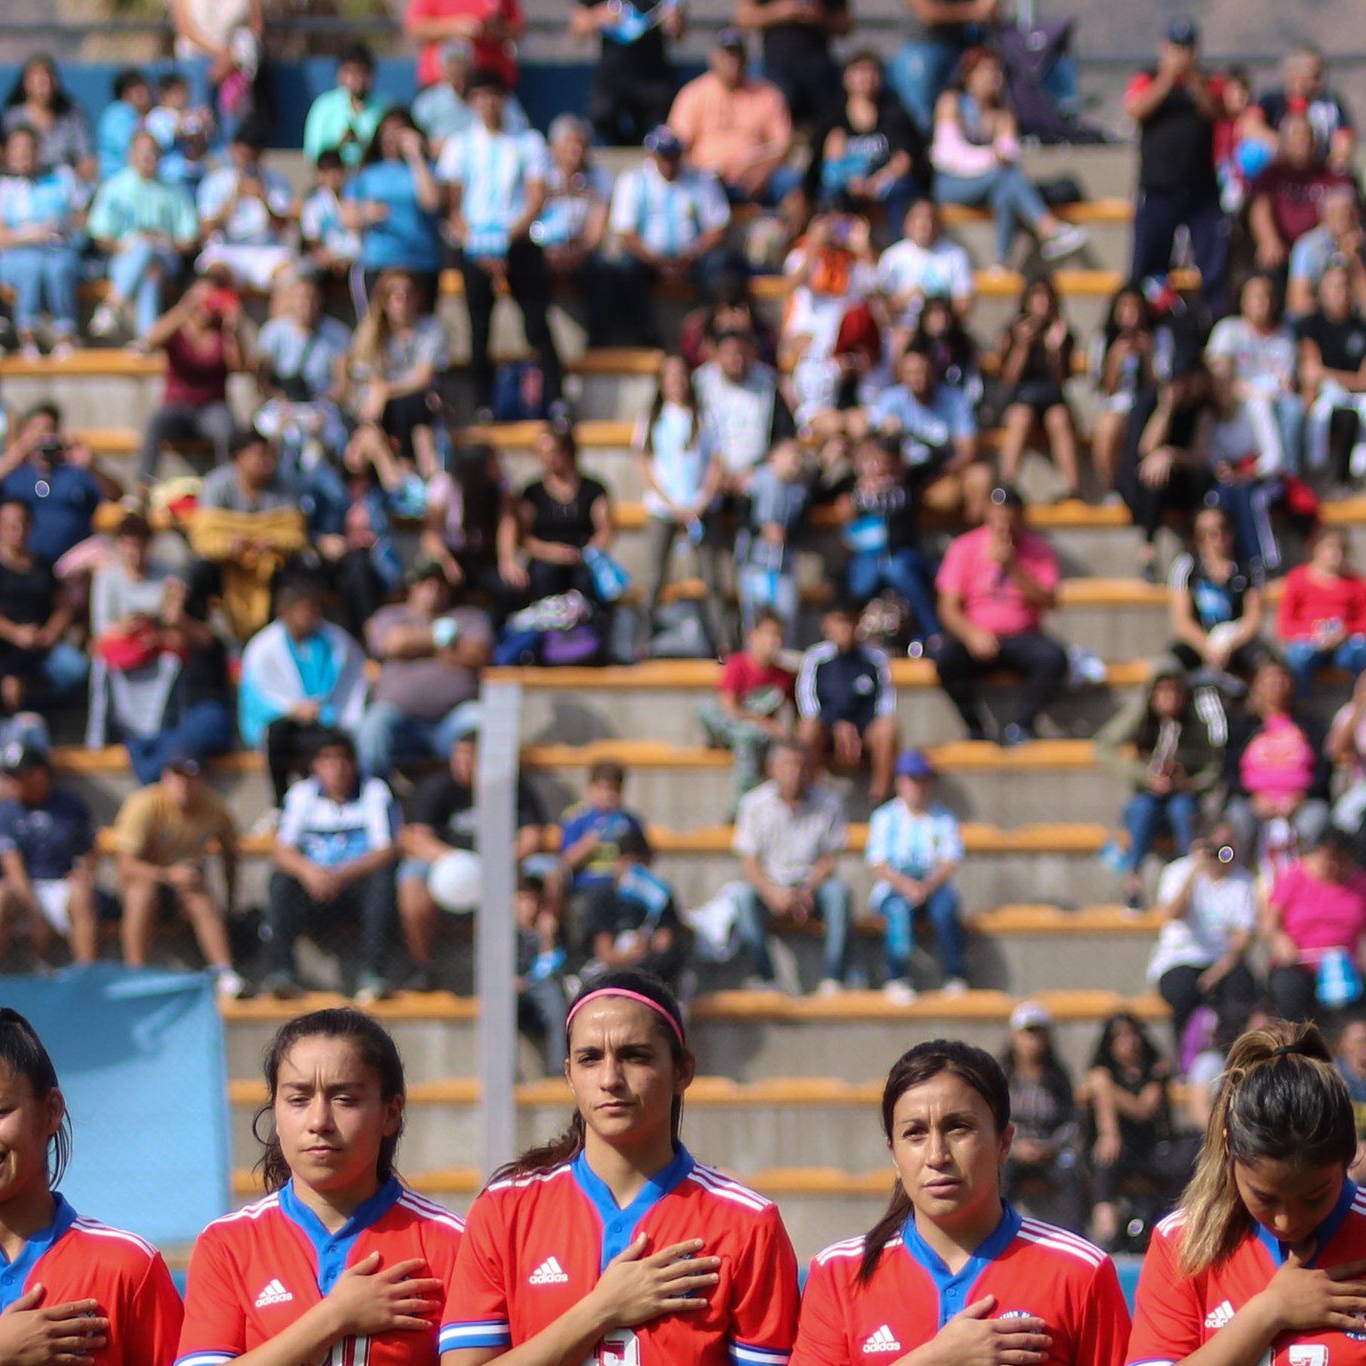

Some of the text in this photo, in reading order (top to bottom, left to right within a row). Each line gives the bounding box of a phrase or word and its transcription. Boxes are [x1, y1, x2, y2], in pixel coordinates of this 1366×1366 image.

[529, 1271, 569, 1285] adidas
[255, 1291, 293, 1308] adidas
[862, 1340, 901, 1353] adidas
